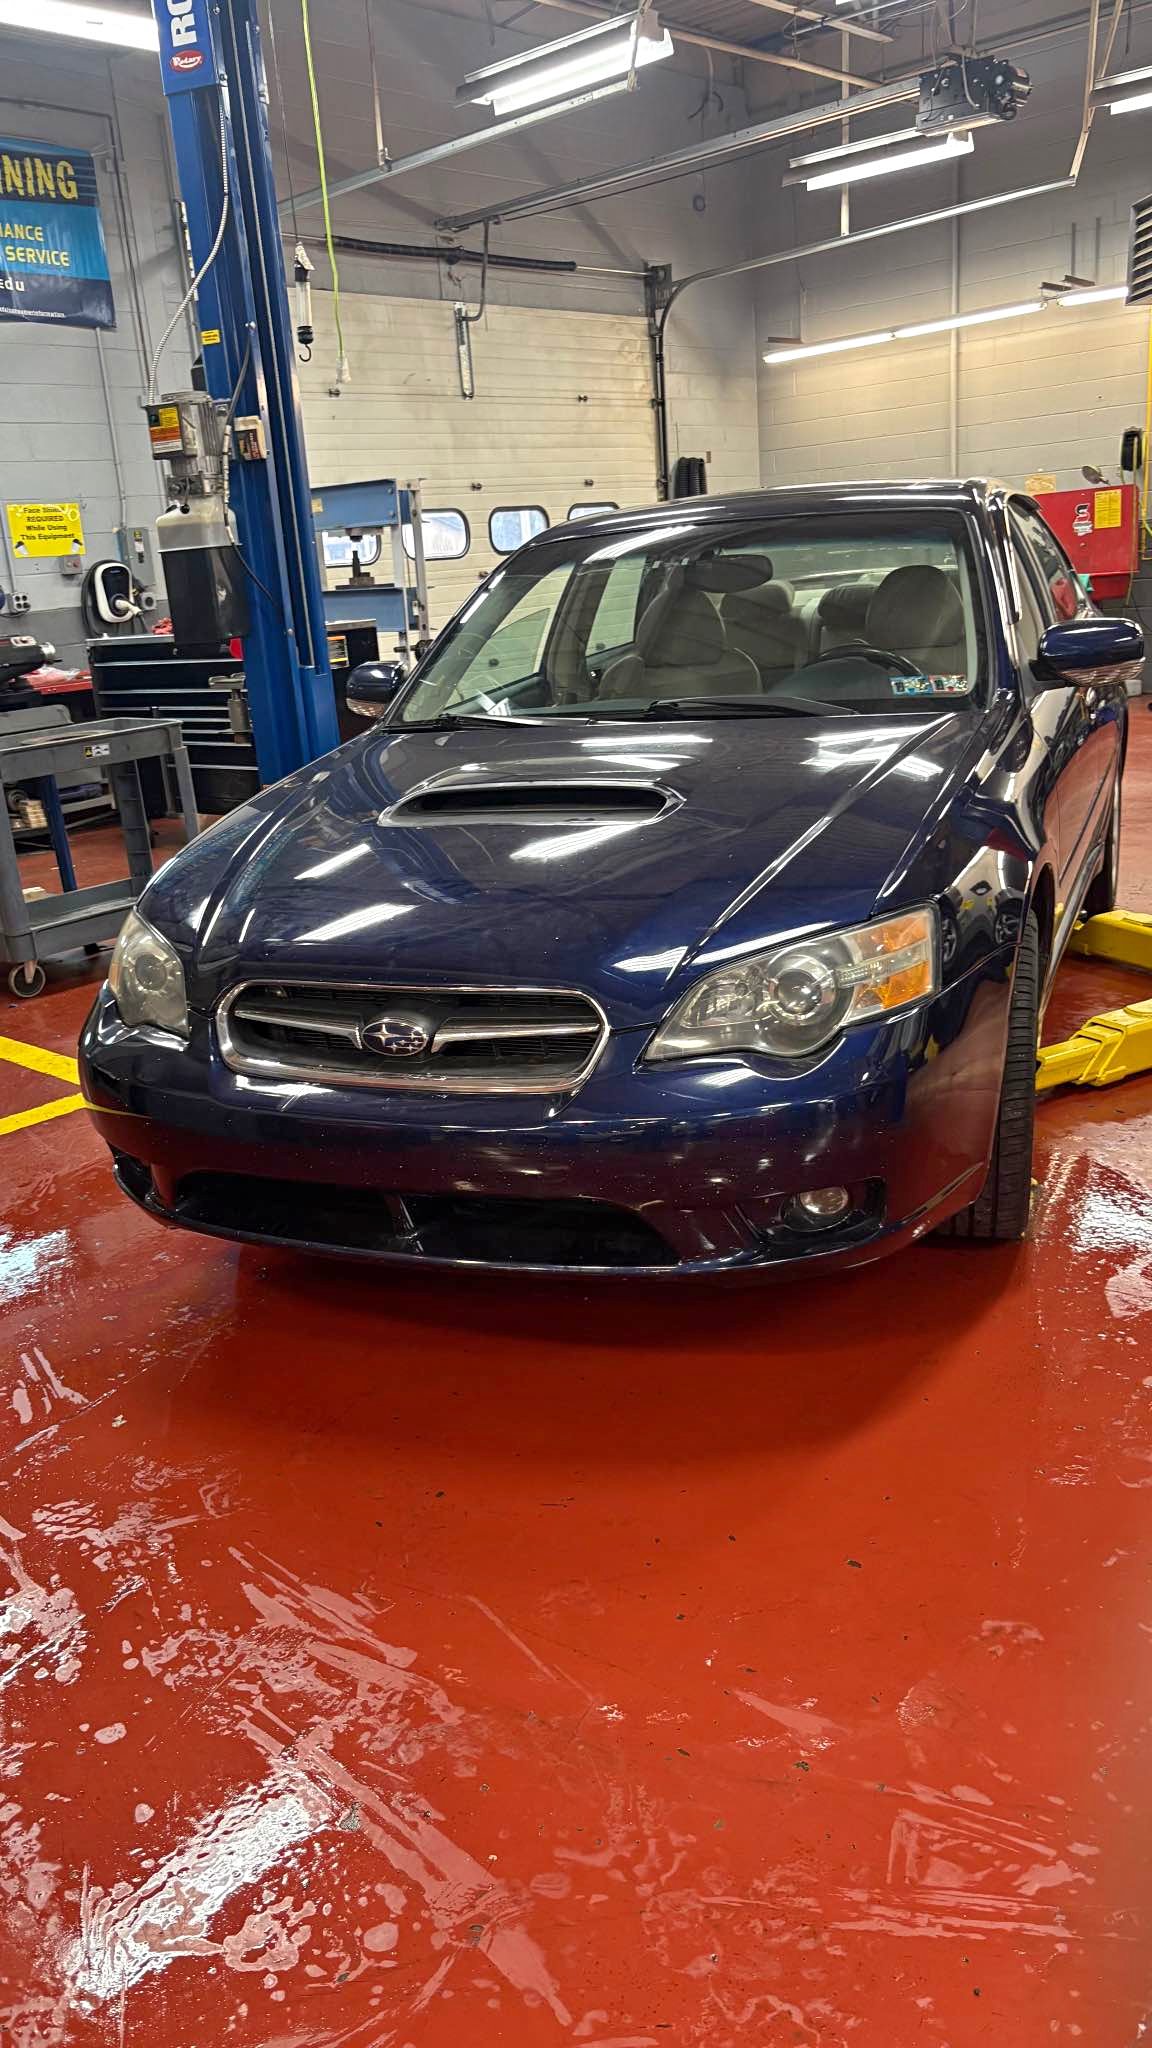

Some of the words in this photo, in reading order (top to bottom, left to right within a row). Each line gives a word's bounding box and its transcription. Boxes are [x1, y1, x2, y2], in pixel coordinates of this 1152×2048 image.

[0, 154, 78, 200] NING
[5, 245, 71, 267] SERVICE
[47, 524, 68, 532] Using
[38, 533, 75, 541] Equipment
